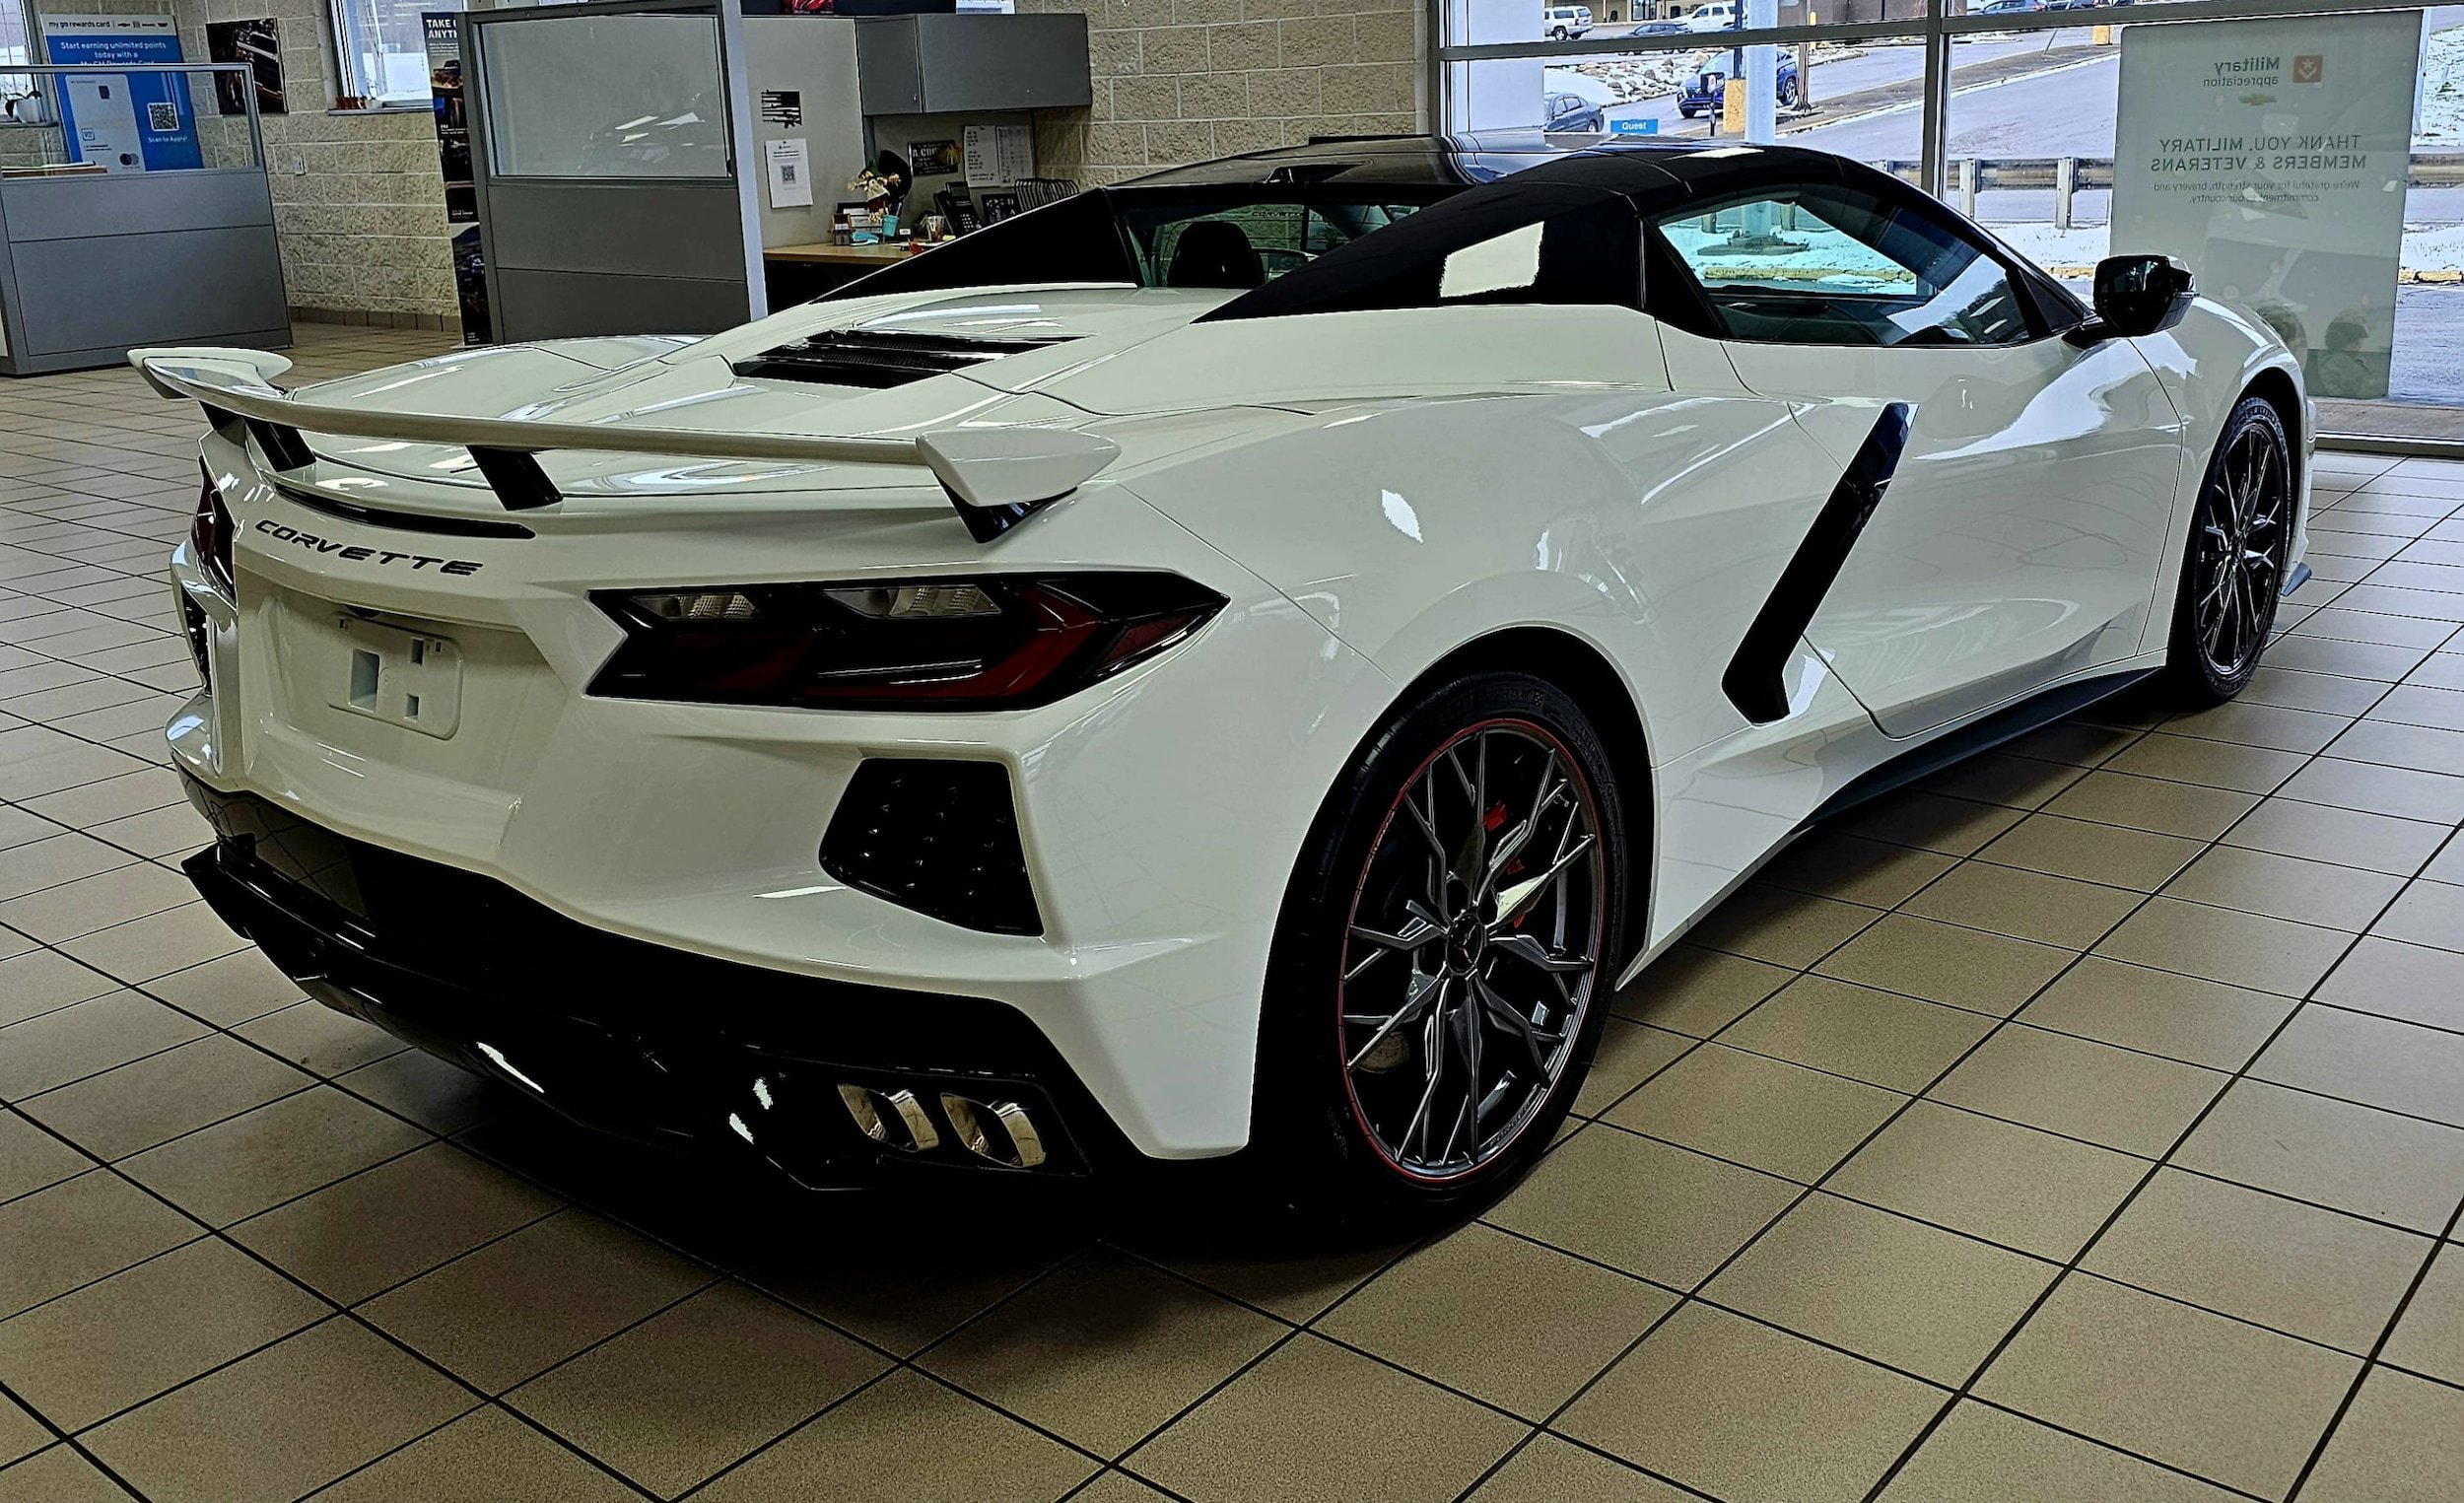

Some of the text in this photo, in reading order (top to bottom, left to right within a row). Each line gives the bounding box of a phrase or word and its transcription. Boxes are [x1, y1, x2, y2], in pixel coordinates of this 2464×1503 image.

[426, 19, 451, 28] TAKE
[145, 41, 167, 50] points
[1621, 121, 1647, 130] Guest
[254, 518, 484, 577] CORVETTE
